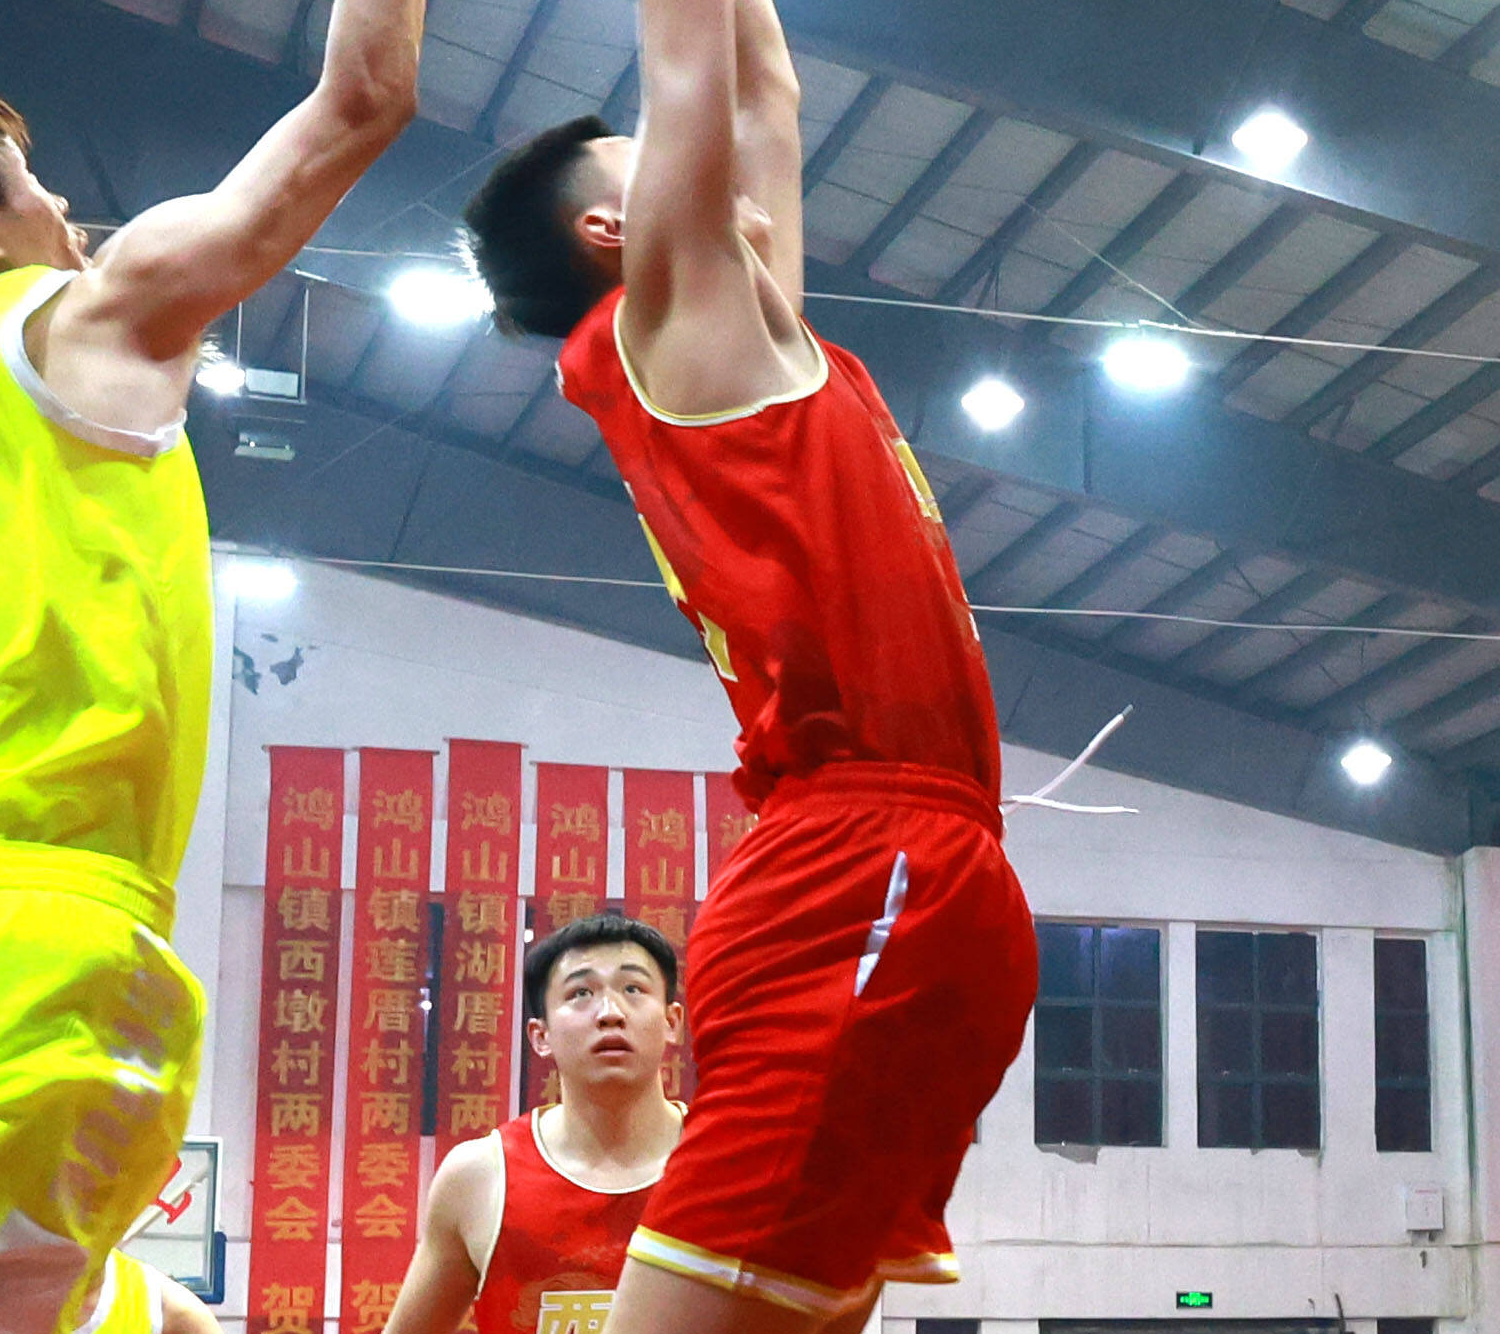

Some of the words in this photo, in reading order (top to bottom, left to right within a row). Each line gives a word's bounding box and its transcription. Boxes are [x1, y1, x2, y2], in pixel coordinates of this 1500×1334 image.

[264, 788, 335, 1242] 鸿山镇西墩村两委会
[350, 1280, 401, 1334] 贺
